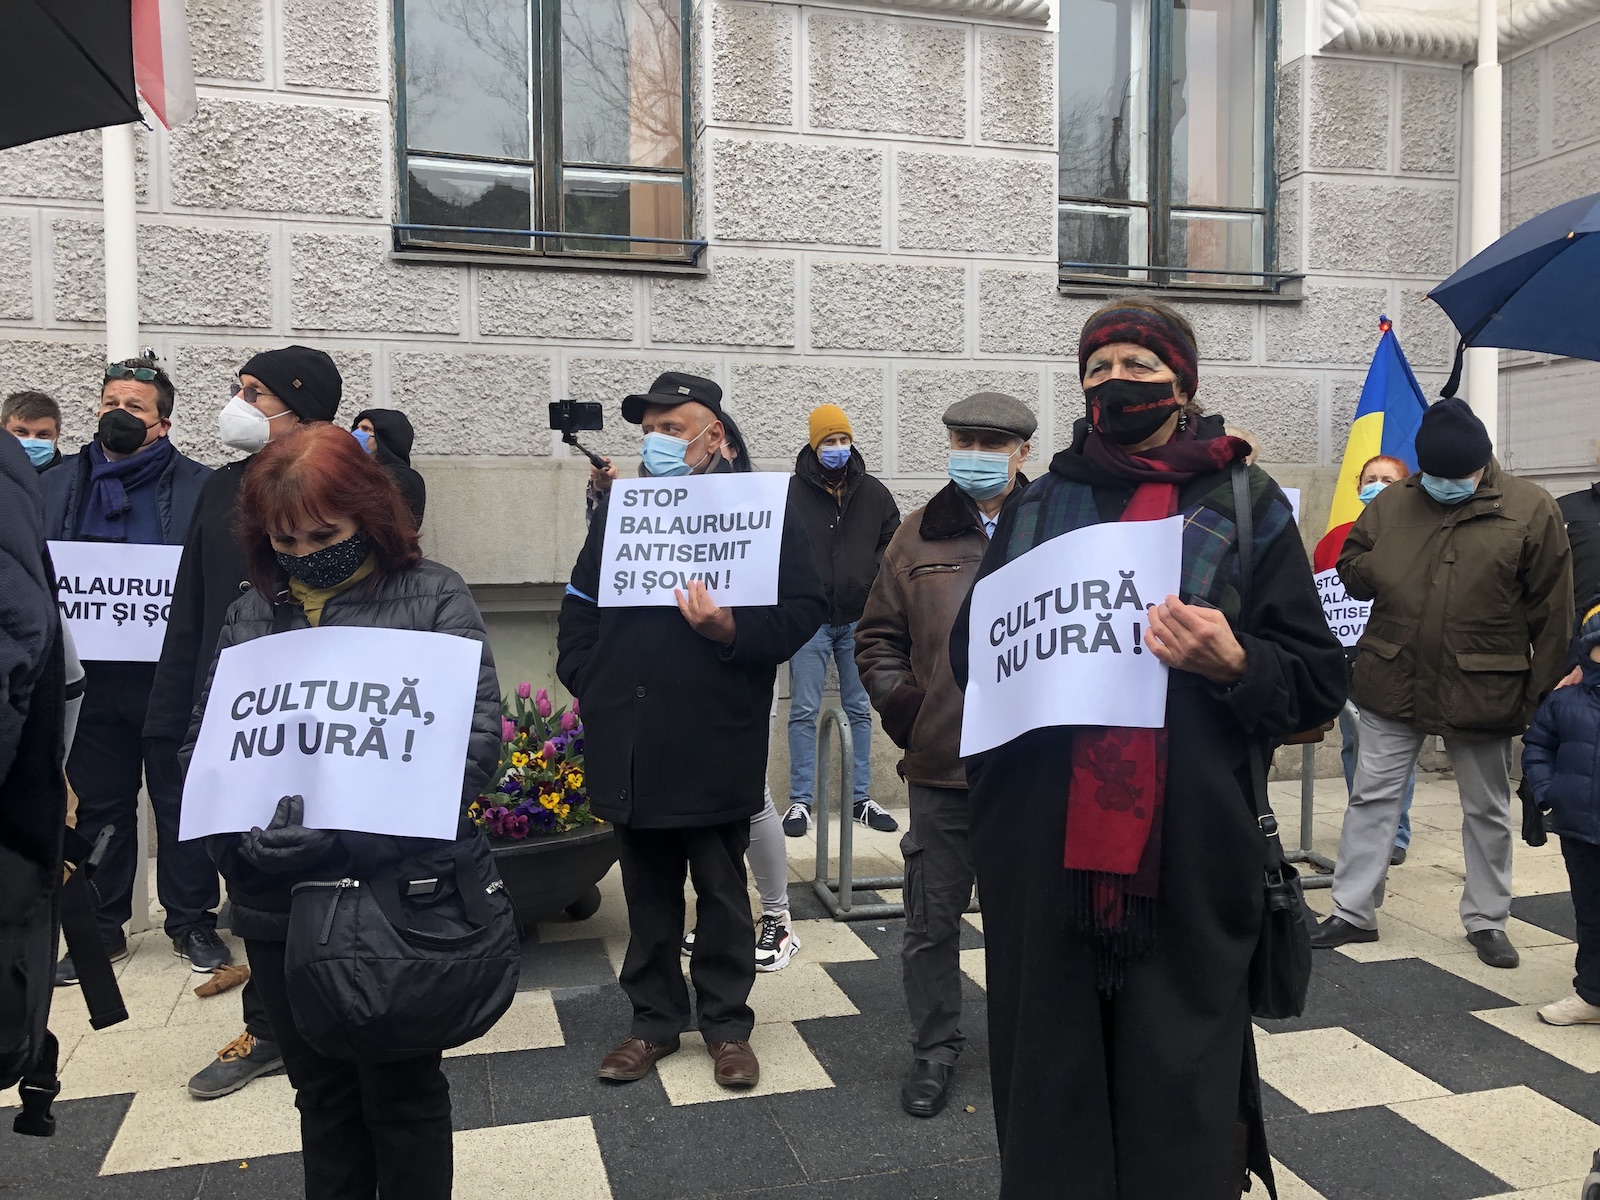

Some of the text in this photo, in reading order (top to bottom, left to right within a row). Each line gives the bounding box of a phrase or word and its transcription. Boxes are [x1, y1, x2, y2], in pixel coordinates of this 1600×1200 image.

[622, 488, 688, 507] STOP
[619, 510, 772, 535] BALAURULUI
[615, 539, 752, 563] ANTISEMIT
[1320, 592, 1352, 606] ALA
[996, 639, 1029, 684] NU
[1035, 612, 1122, 661] URĂ
[230, 676, 436, 726] CULTURĂ,
[229, 723, 286, 762] NU
[298, 716, 389, 760] URĂ
